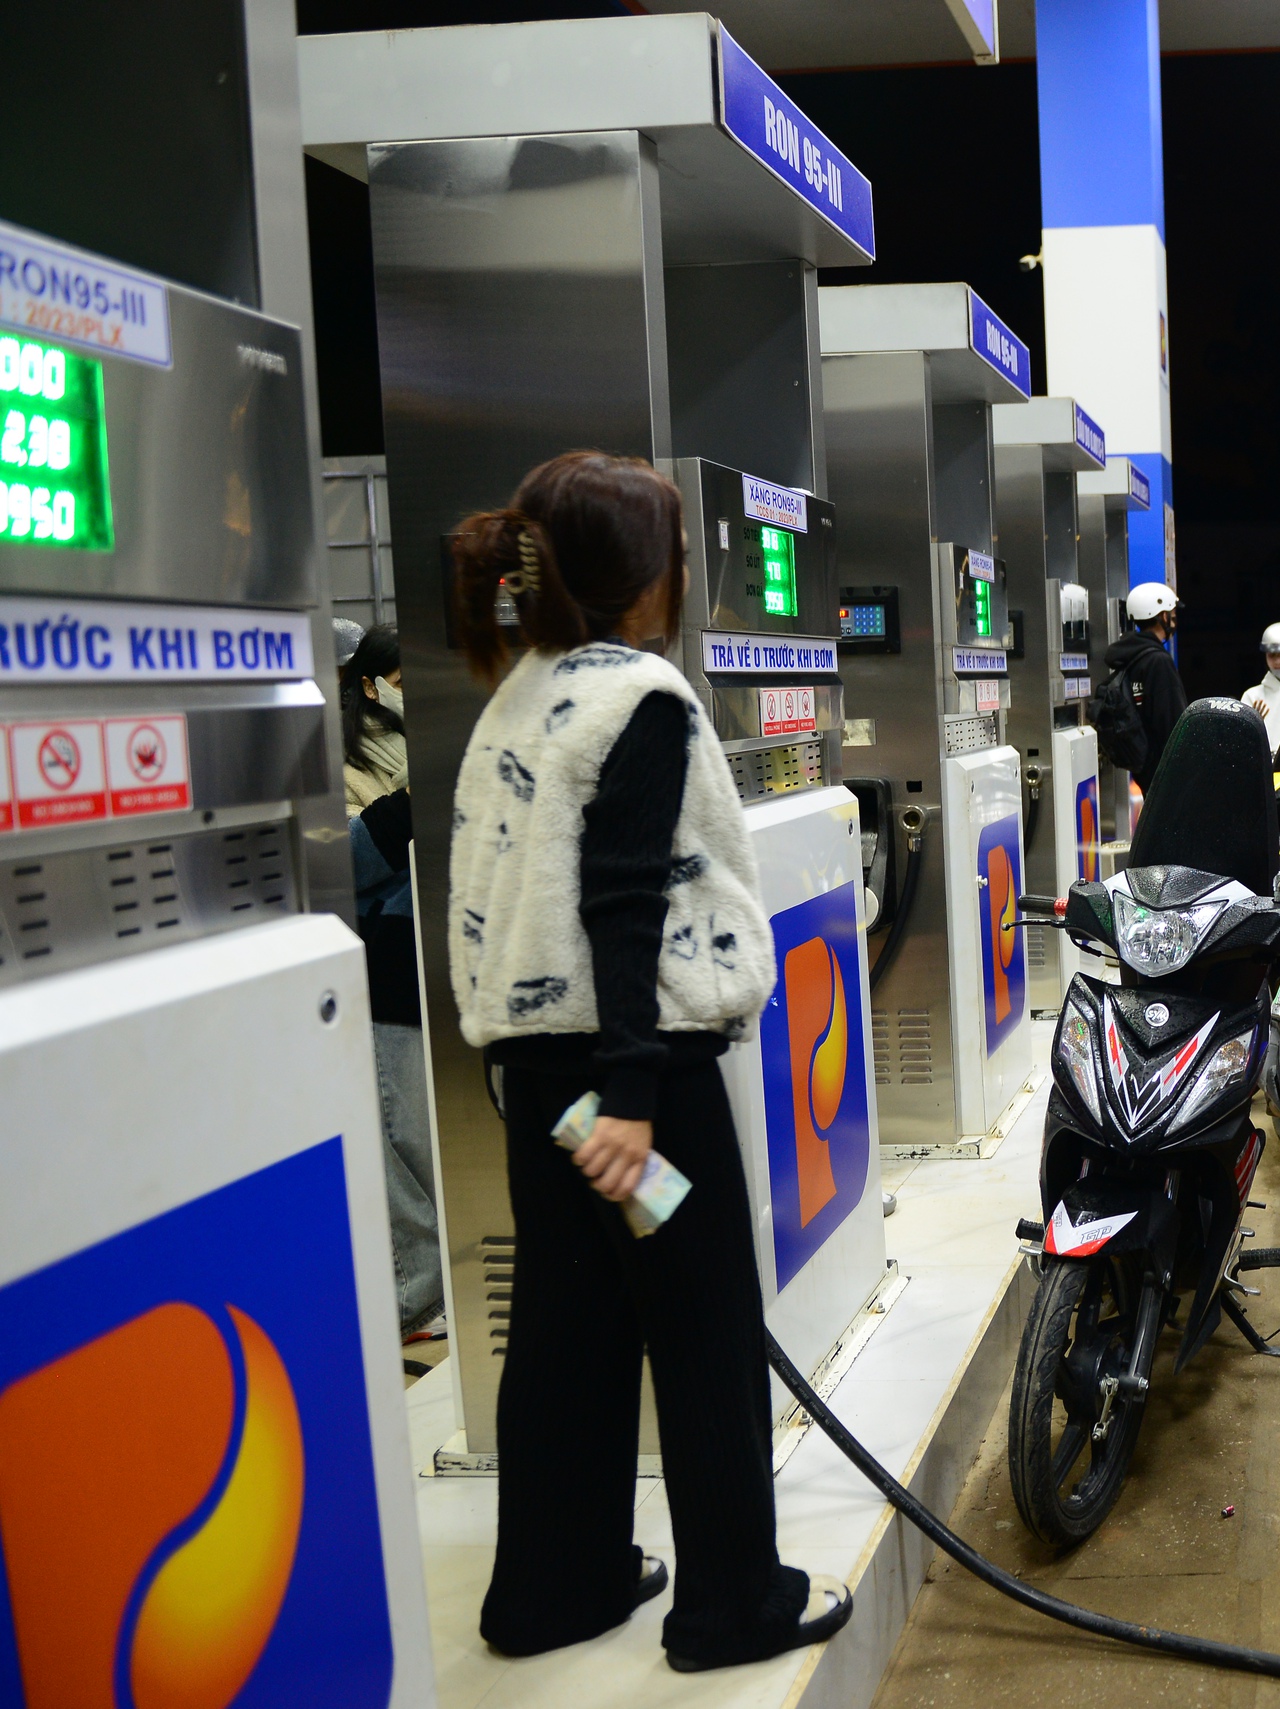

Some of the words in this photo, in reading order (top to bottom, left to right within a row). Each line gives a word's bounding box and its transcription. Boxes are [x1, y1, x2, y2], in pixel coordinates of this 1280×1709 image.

[764, 95, 800, 174] RON
[803, 137, 843, 212] 95-III
[986, 319, 1001, 361] RON
[756, 505, 769, 519] TCCS
[772, 491, 802, 516] RON95-III
[129, 626, 198, 671] KHI
[212, 627, 295, 671] BƠM
[712, 637, 734, 667] TRẢ
[737, 639, 751, 667] VỀ
[763, 643, 795, 668] TRƯỚC
[797, 648, 812, 668] KHI
[814, 647, 833, 668] BƠM
[1147, 1006, 1168, 1022] SYM
[1080, 1225, 1113, 1244] GP
